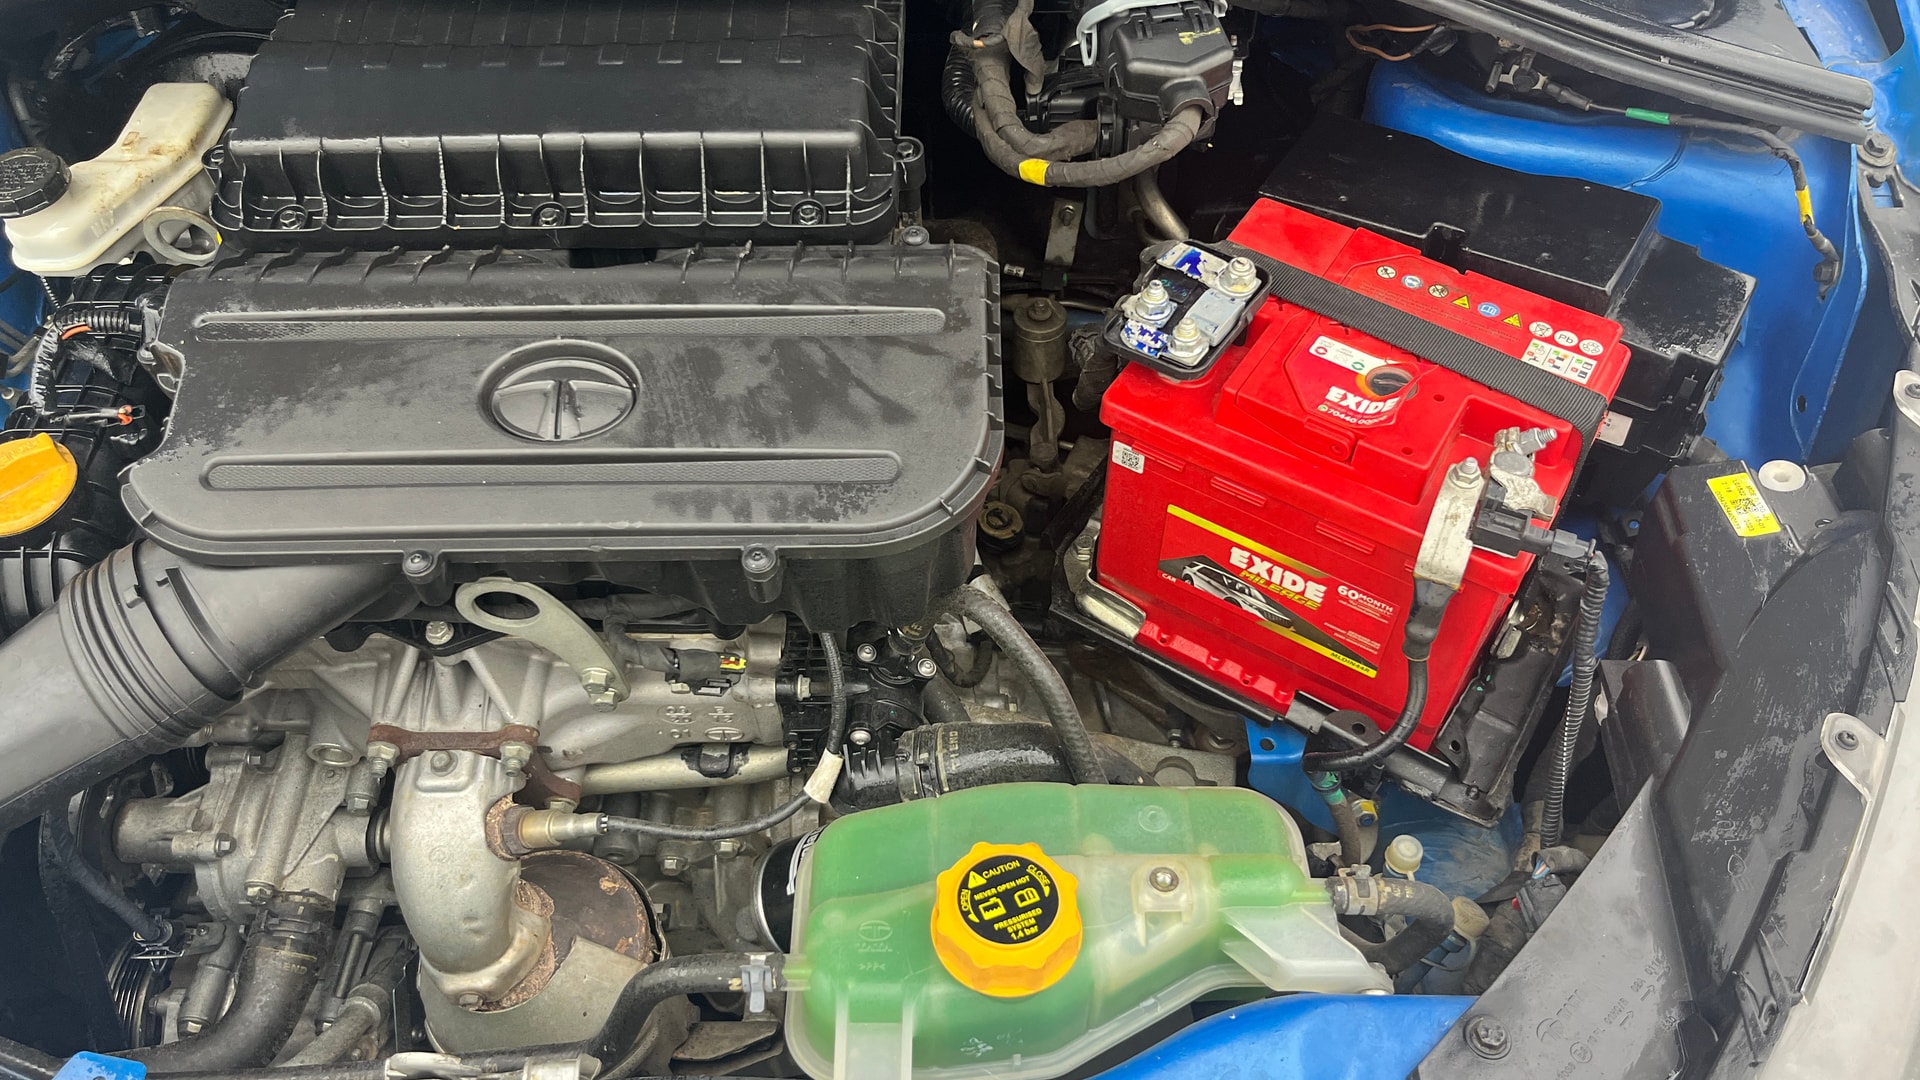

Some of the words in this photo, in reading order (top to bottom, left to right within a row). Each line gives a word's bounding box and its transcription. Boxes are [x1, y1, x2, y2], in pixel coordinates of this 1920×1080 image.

[1558, 334, 1574, 344] Pb
[1325, 386, 1400, 414] EXIDE
[1162, 573, 1177, 583] CAR
[1230, 546, 1327, 603] EXIDE
[1239, 570, 1321, 611] MILEAGE
[1338, 586, 1359, 600] 60
[1358, 594, 1394, 612] MONTH
[982, 860, 1020, 878] CAUTION
[1028, 864, 1050, 886] CLOSE
[974, 888, 997, 900] NEVER
[996, 880, 1016, 892] OPEN
[1016, 875, 1030, 886] HOT
[960, 888, 970, 912] OPEN
[994, 908, 1042, 931] PRESSURISED
[1007, 918, 1036, 933] SYSTEM
[1010, 930, 1024, 940] 1.4
[1024, 925, 1038, 936] bar
